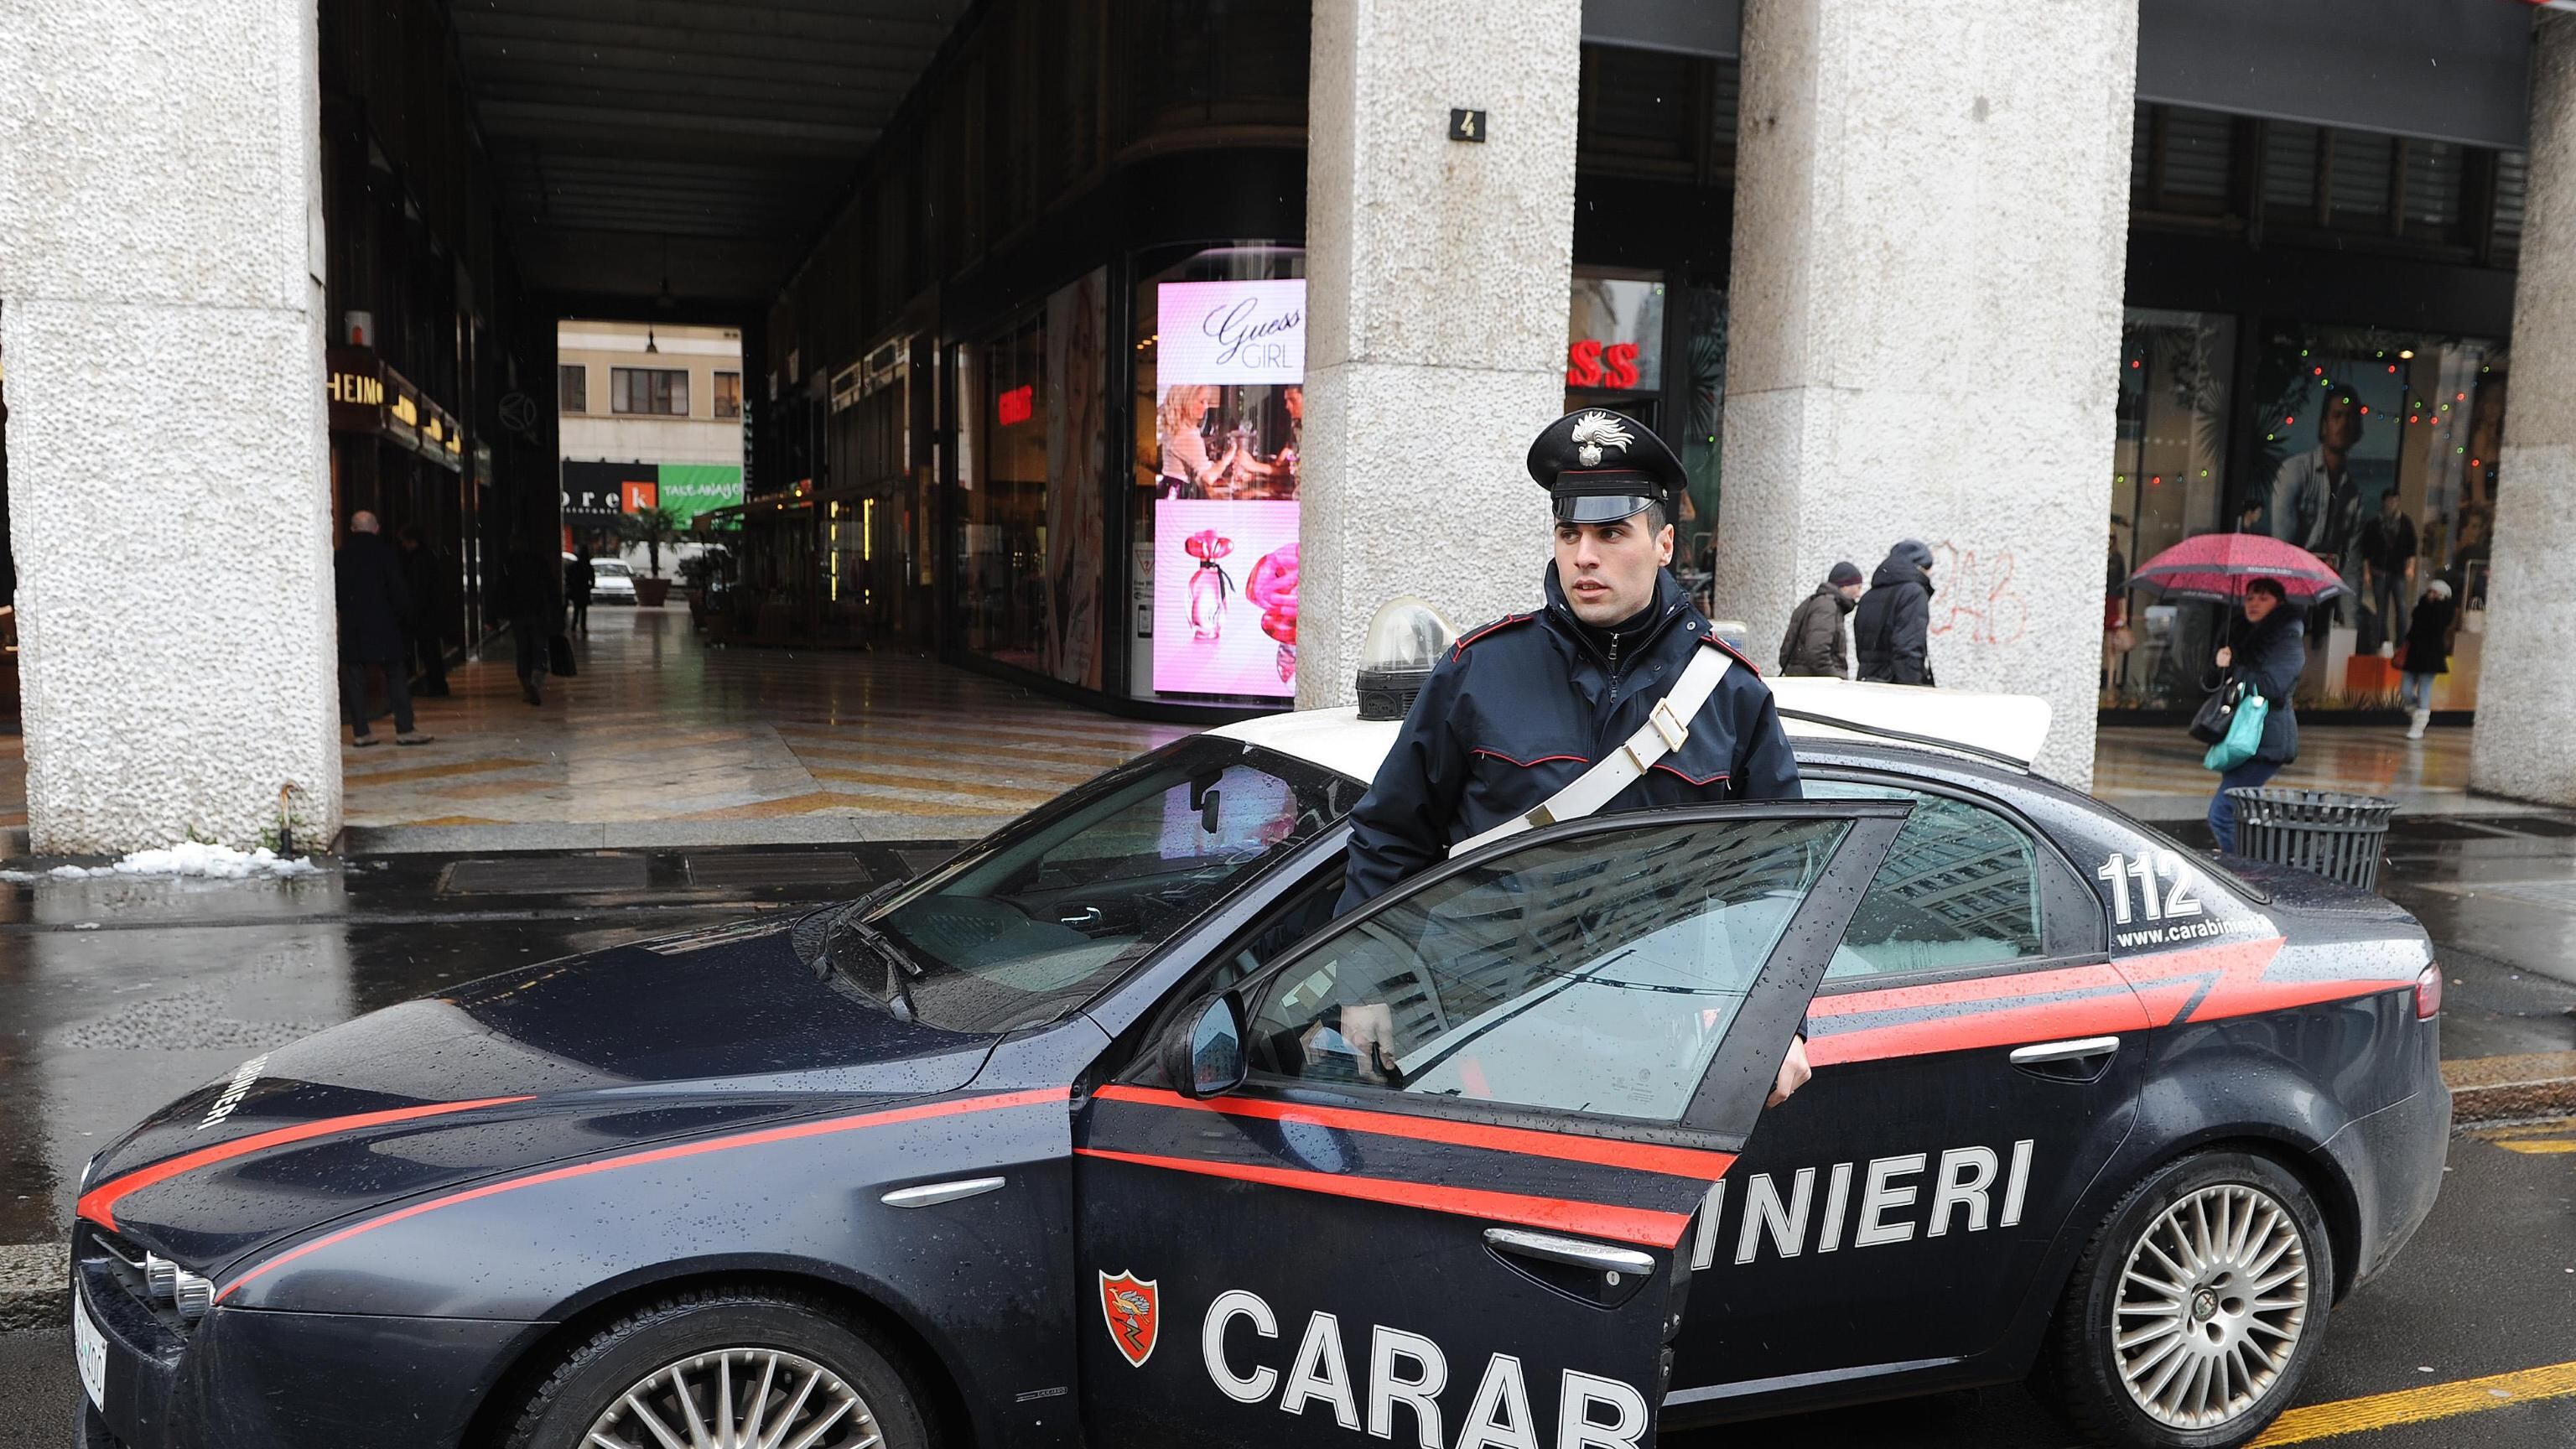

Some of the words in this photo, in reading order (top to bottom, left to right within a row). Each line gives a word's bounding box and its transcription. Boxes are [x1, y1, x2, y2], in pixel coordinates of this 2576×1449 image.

[1460, 111, 1475, 137] 4
[1203, 297, 1300, 365] Guess
[1242, 343, 1293, 368] GIRL
[2098, 849, 2202, 924] 112
